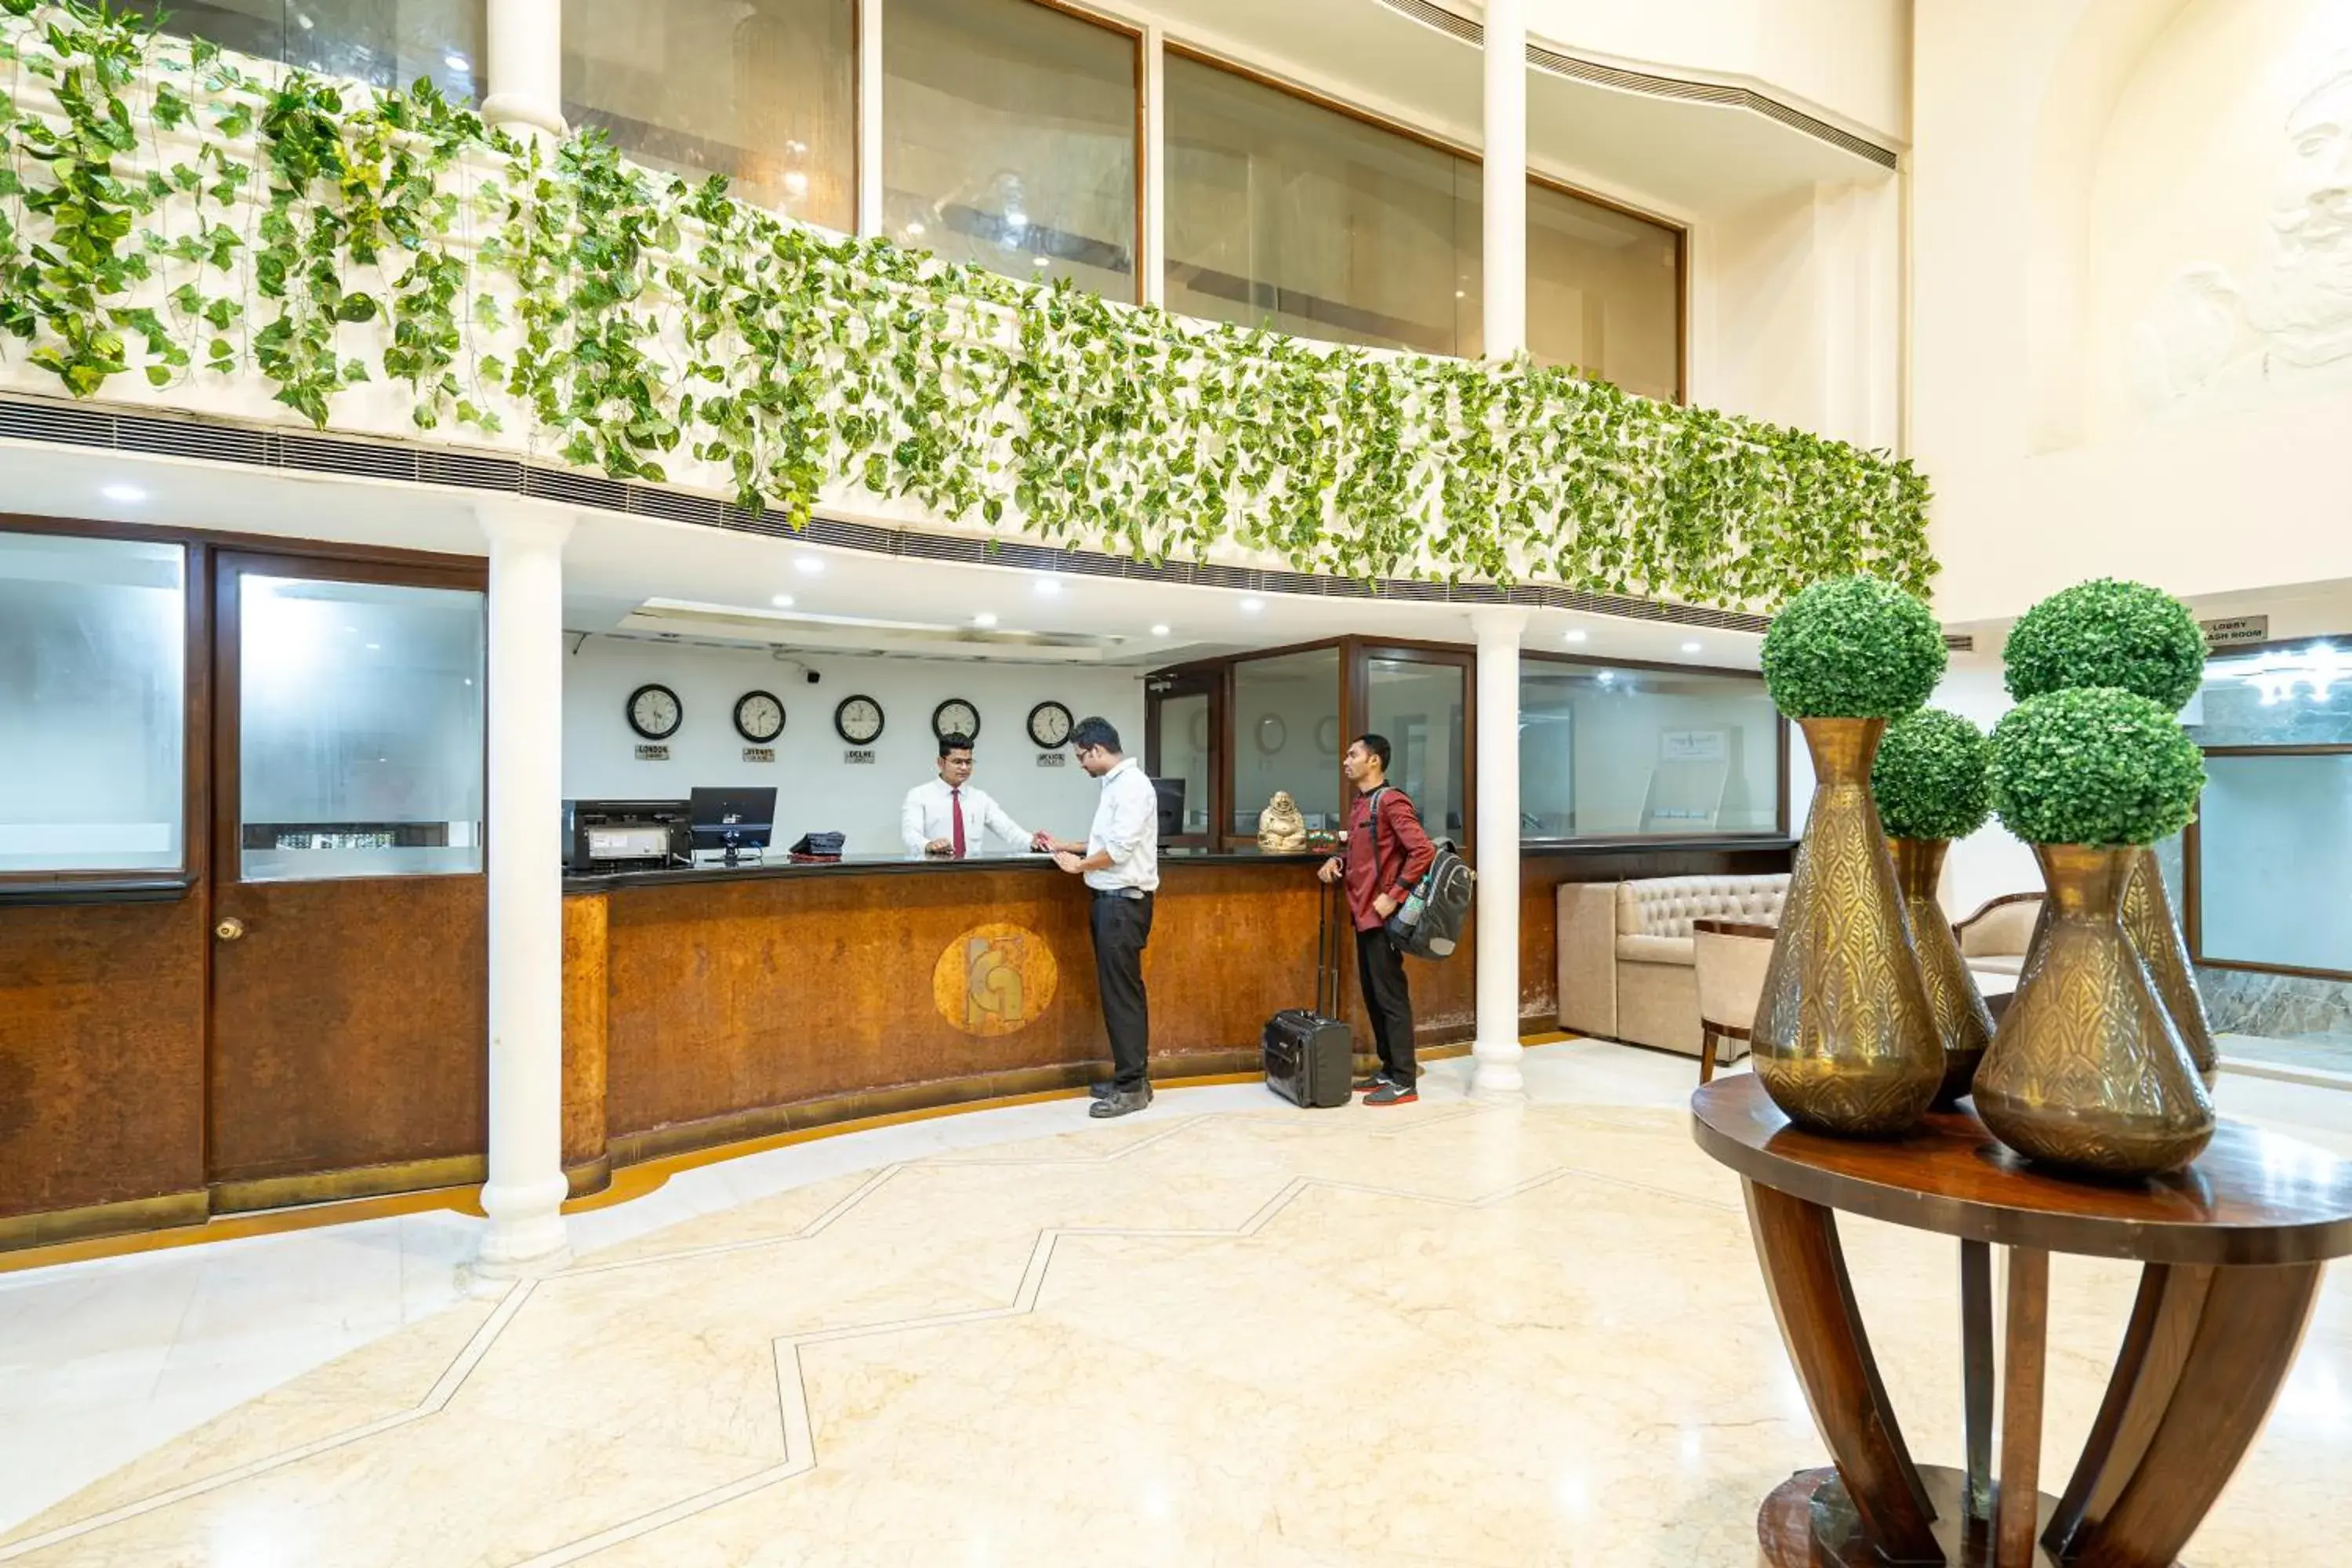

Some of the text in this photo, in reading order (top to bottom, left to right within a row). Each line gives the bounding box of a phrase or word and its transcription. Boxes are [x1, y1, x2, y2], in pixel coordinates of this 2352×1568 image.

[2213, 621, 2246, 631] LOBBY
[2204, 630, 2262, 641] ASH ROOM
[638, 745, 668, 753] LONDON
